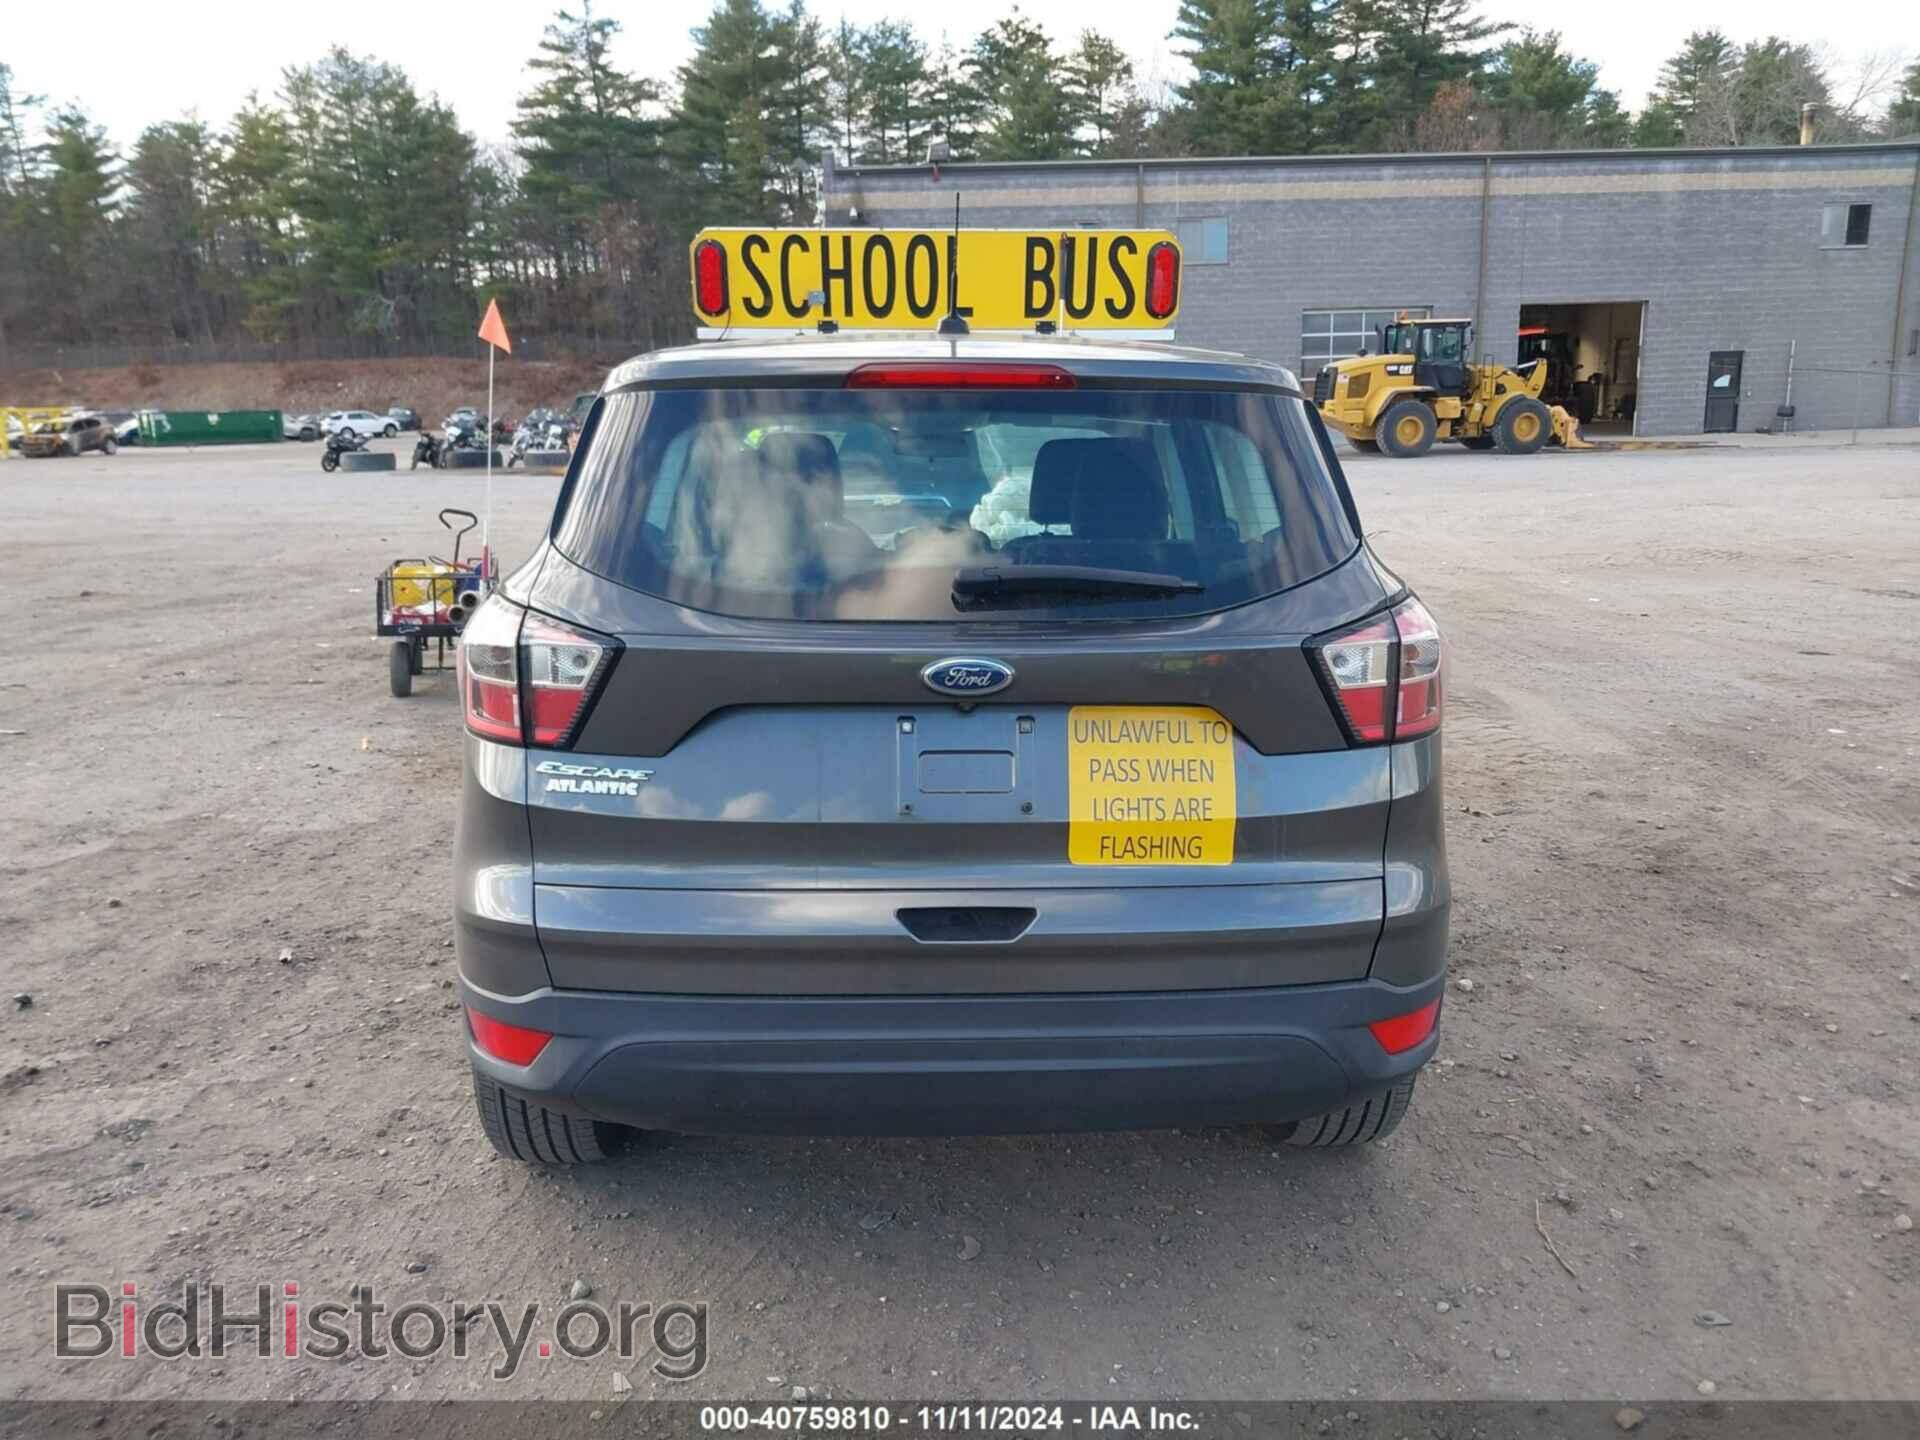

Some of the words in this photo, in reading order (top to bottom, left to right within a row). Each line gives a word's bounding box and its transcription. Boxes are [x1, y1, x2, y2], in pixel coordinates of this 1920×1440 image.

[741, 234, 974, 318] SCHOOL
[1024, 235, 1138, 318] BUS
[945, 666, 991, 686] Ford
[1074, 719, 1194, 744] UNLAWFUL
[1199, 720, 1228, 744] TO
[1089, 758, 1140, 783] PASS
[1147, 759, 1214, 784] WHEN
[545, 778, 638, 795] ATLANTIC
[1092, 797, 1165, 822] LIGHTS
[1172, 798, 1213, 822] ARE
[1099, 836, 1203, 860] FLASHING
